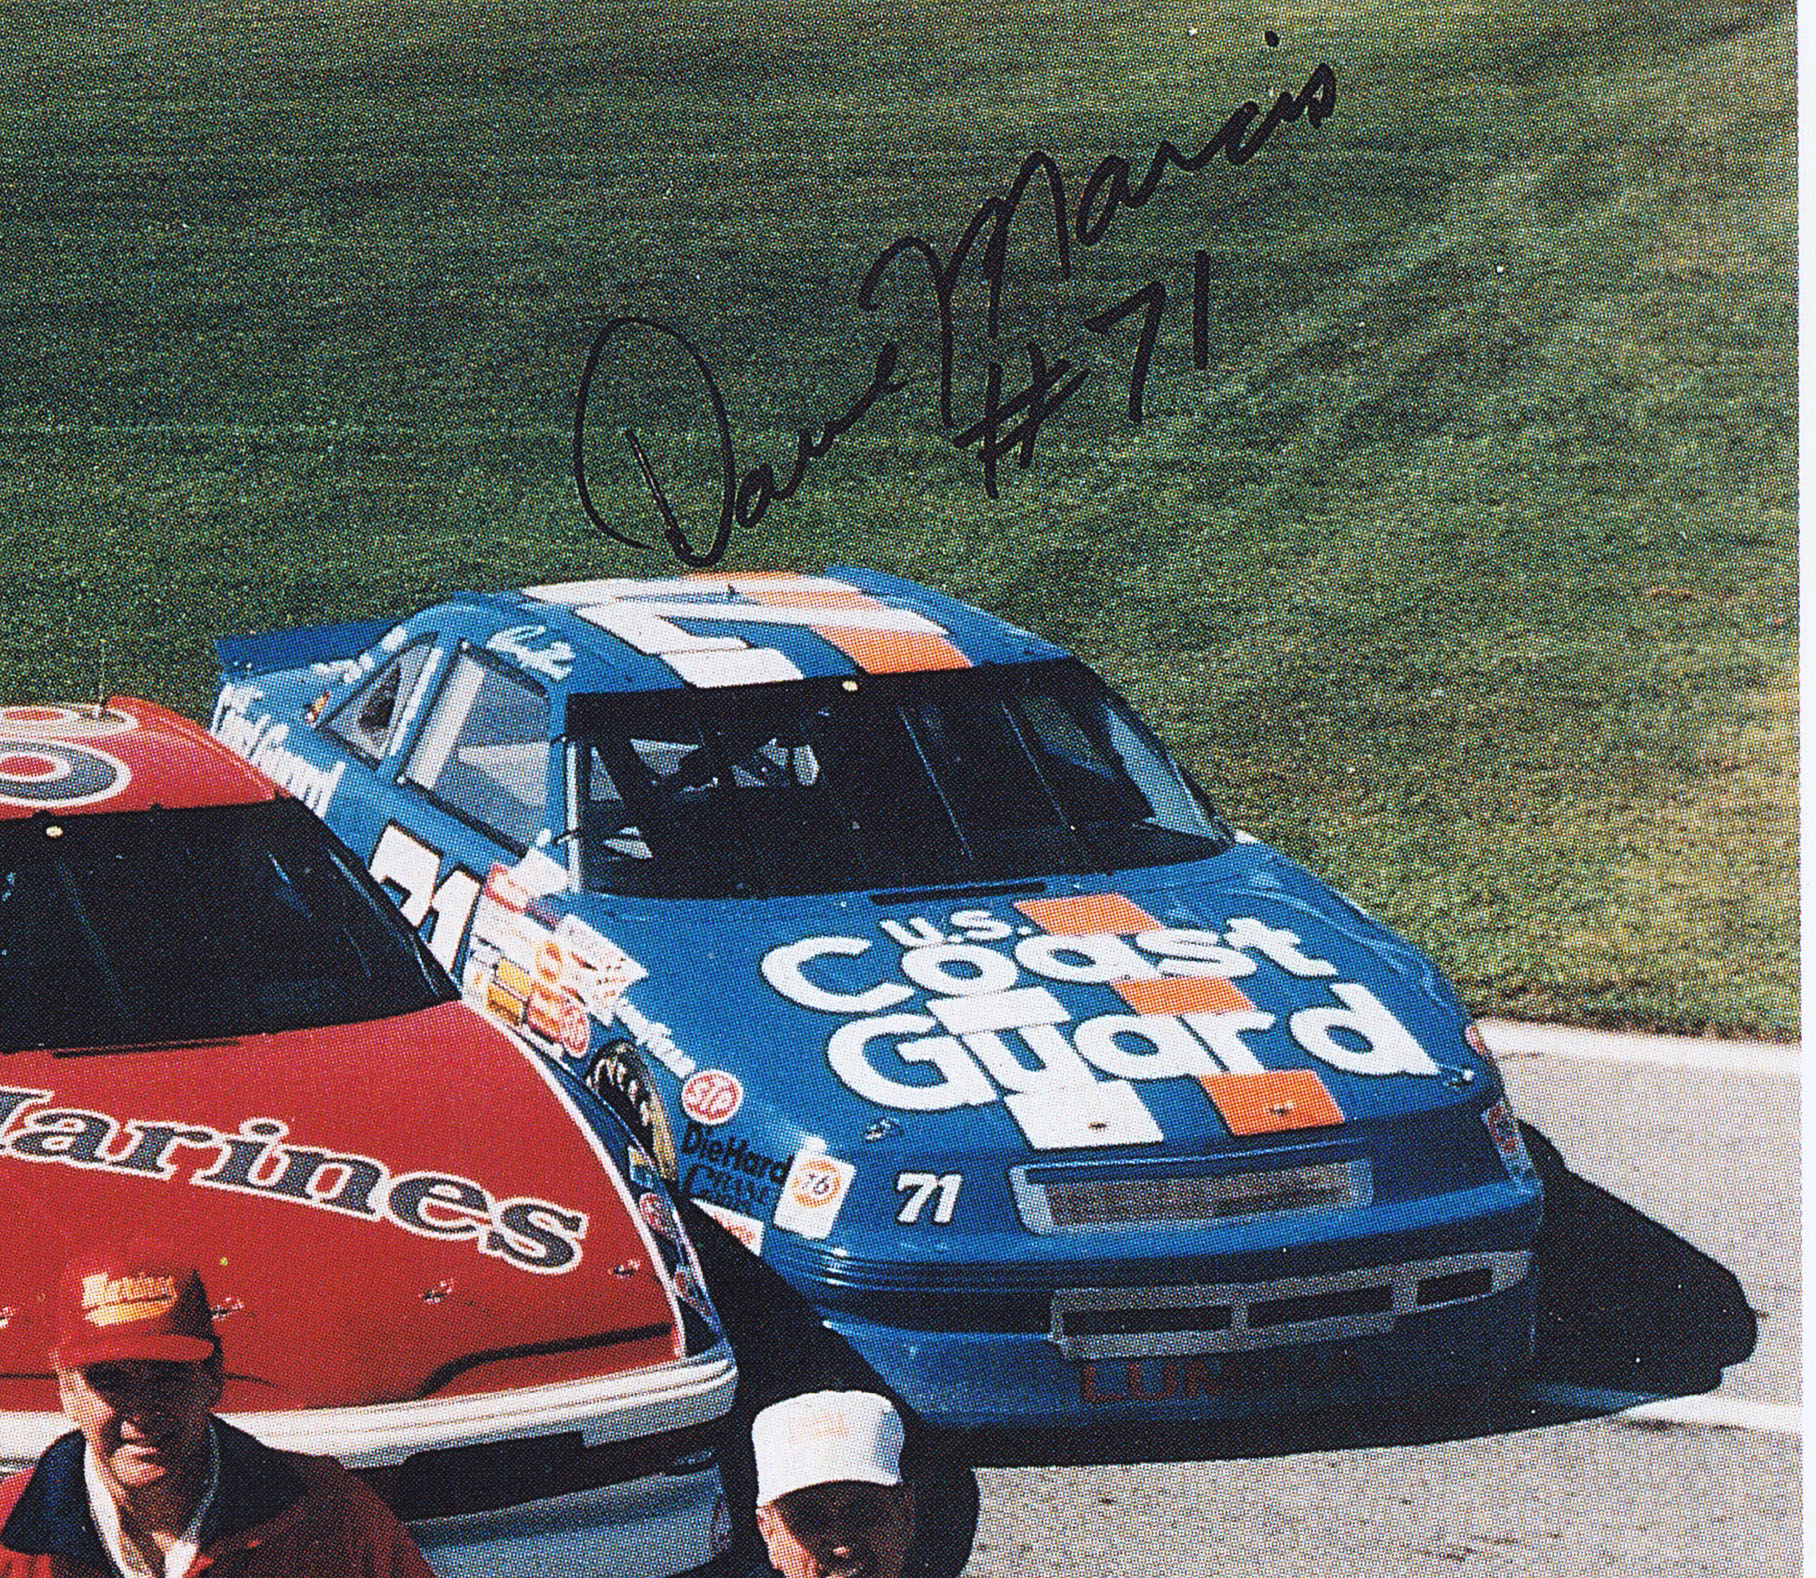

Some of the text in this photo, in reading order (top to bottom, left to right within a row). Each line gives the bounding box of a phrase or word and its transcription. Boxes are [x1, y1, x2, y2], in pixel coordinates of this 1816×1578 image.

[573, 30, 1338, 567] Dave Marcis
[953, 249, 1210, 499] #71
[761, 915, 1338, 1014] Coast
[879, 908, 1033, 947] U.S.
[826, 982, 1443, 1112] Guard
[688, 1077, 738, 1118] STP
[894, 1172, 963, 1226] 71
